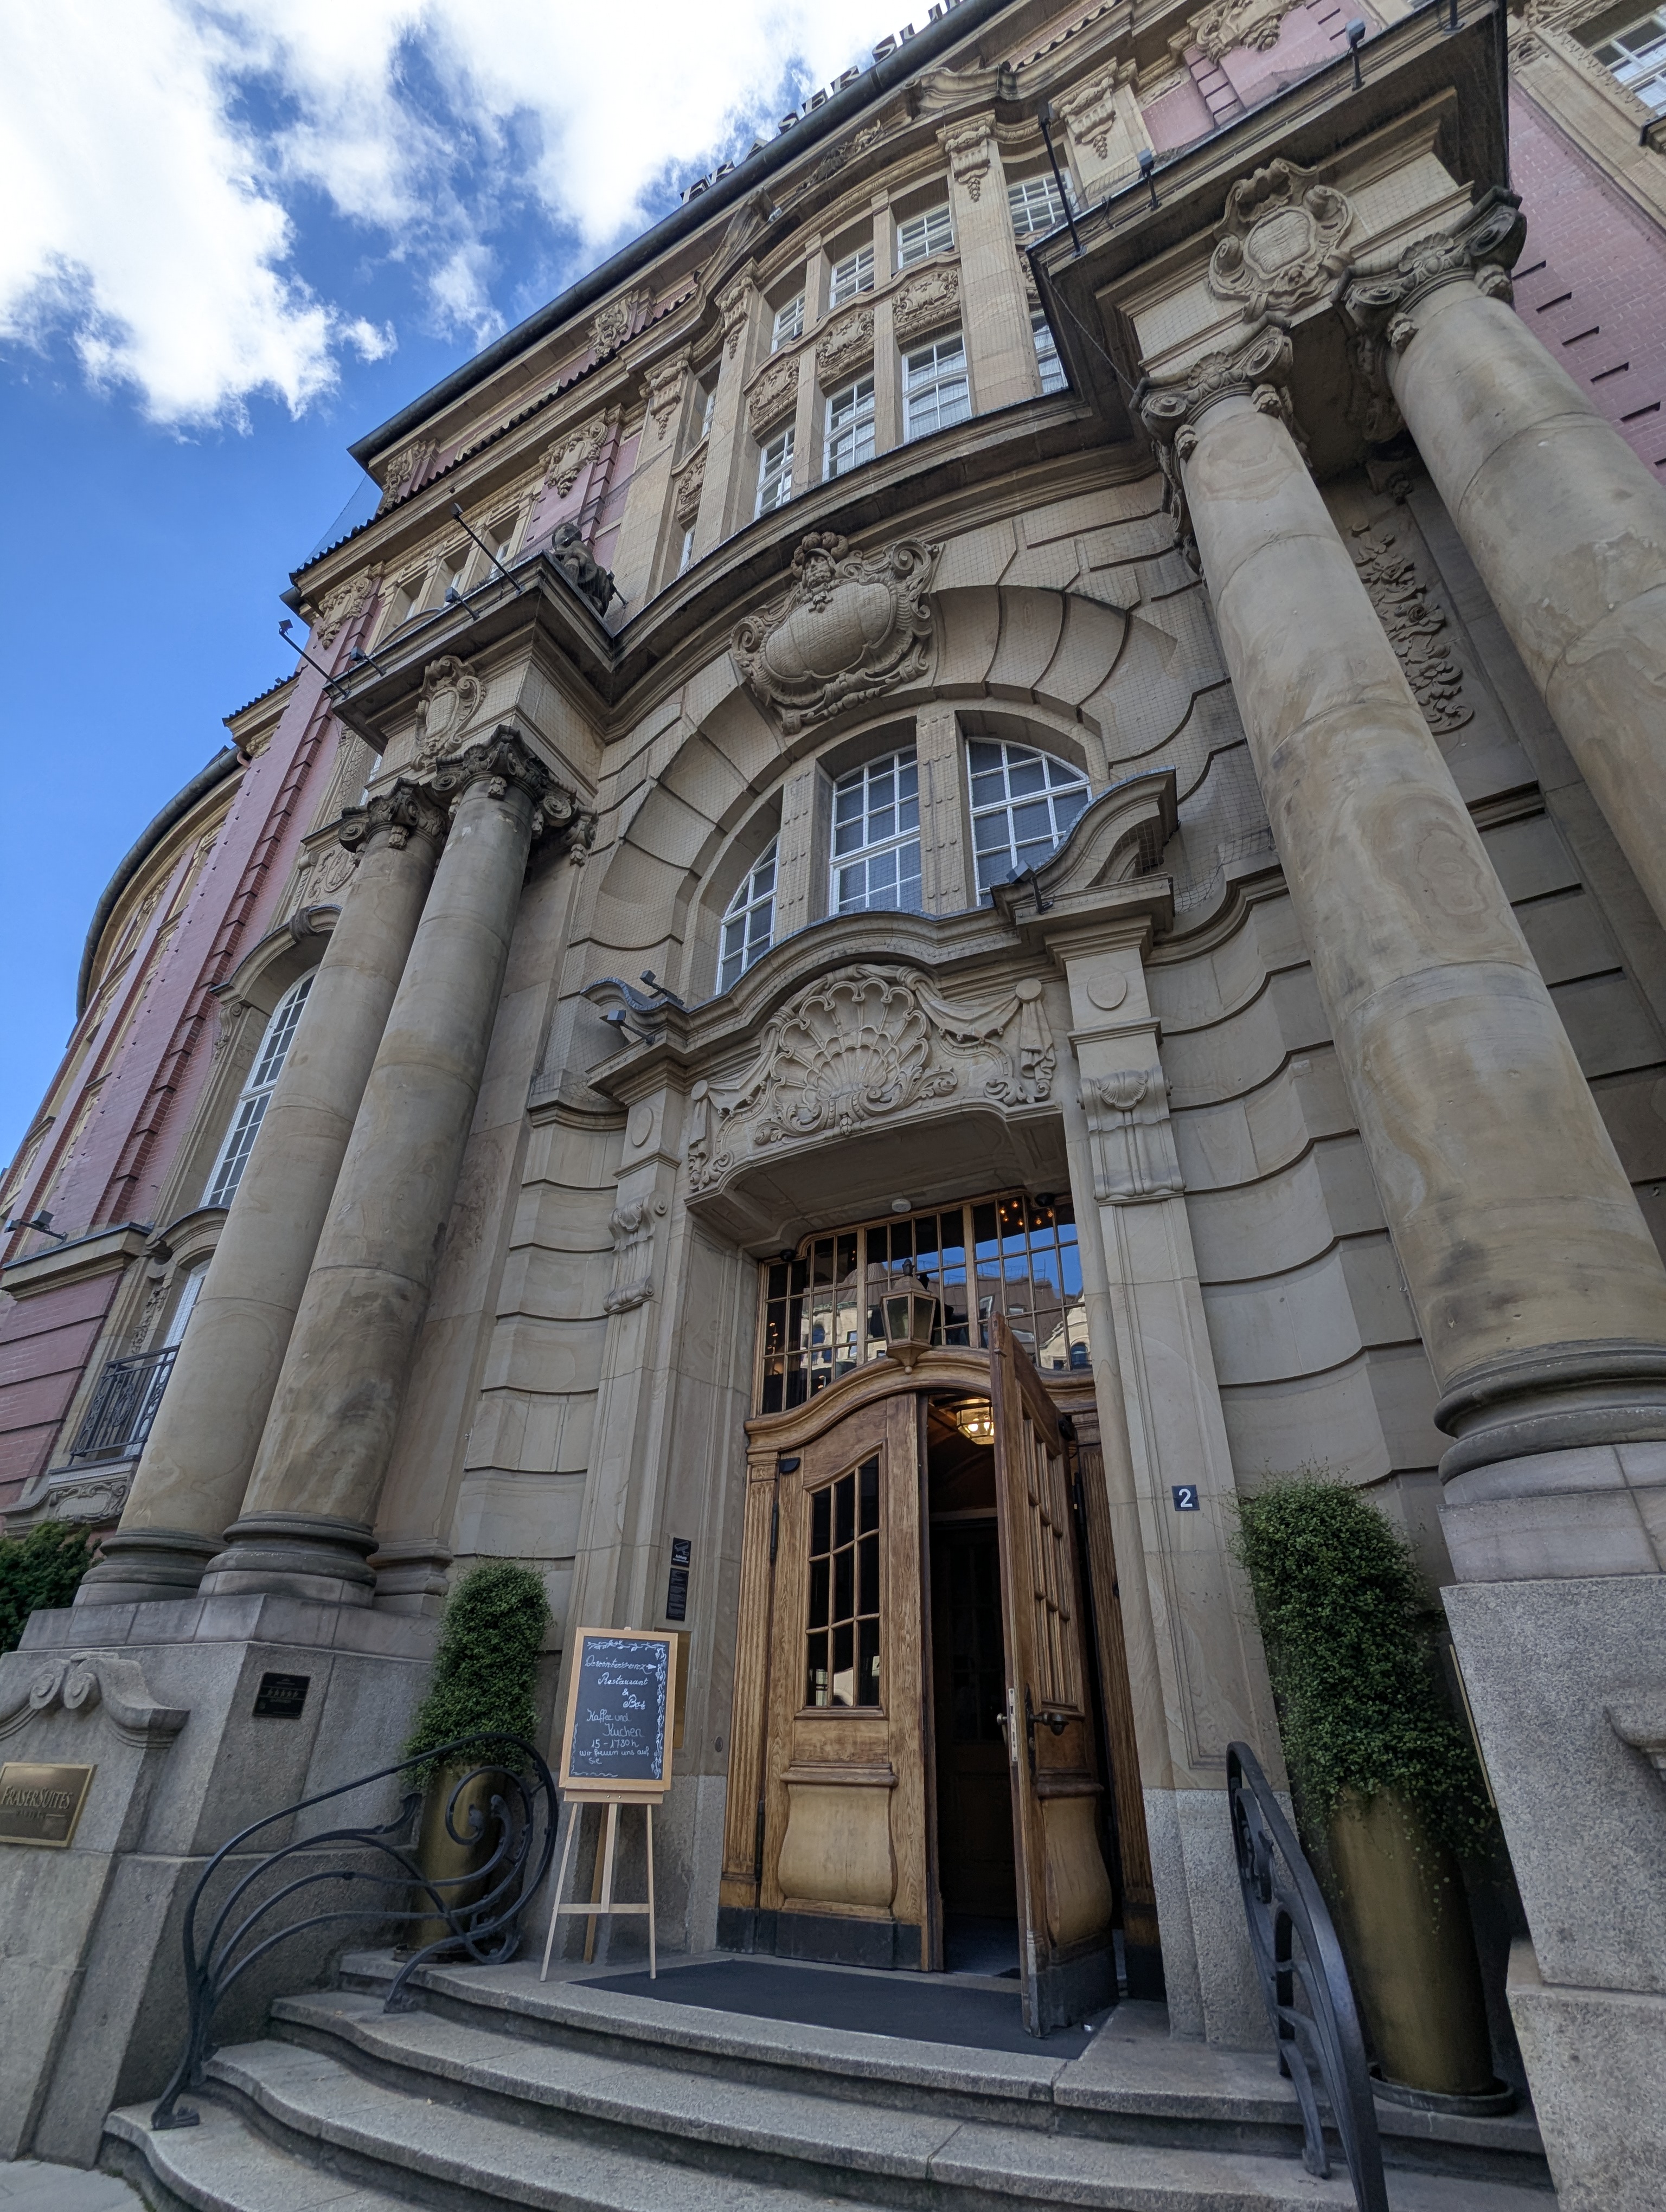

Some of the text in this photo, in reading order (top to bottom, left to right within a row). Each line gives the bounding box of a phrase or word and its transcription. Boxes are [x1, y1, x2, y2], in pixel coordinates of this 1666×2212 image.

[1178, 1488, 1193, 1508] 2
[597, 1672, 649, 1686] Restaurant
[622, 1688, 629, 1696] &
[623, 1694, 646, 1710] Bar
[586, 1708, 632, 1723] Kaffee und
[603, 1722, 645, 1738] Kuchen
[591, 1739, 600, 1749] 15
[594, 1748, 619, 1757] freuen
[637, 1746, 650, 1757] auf
